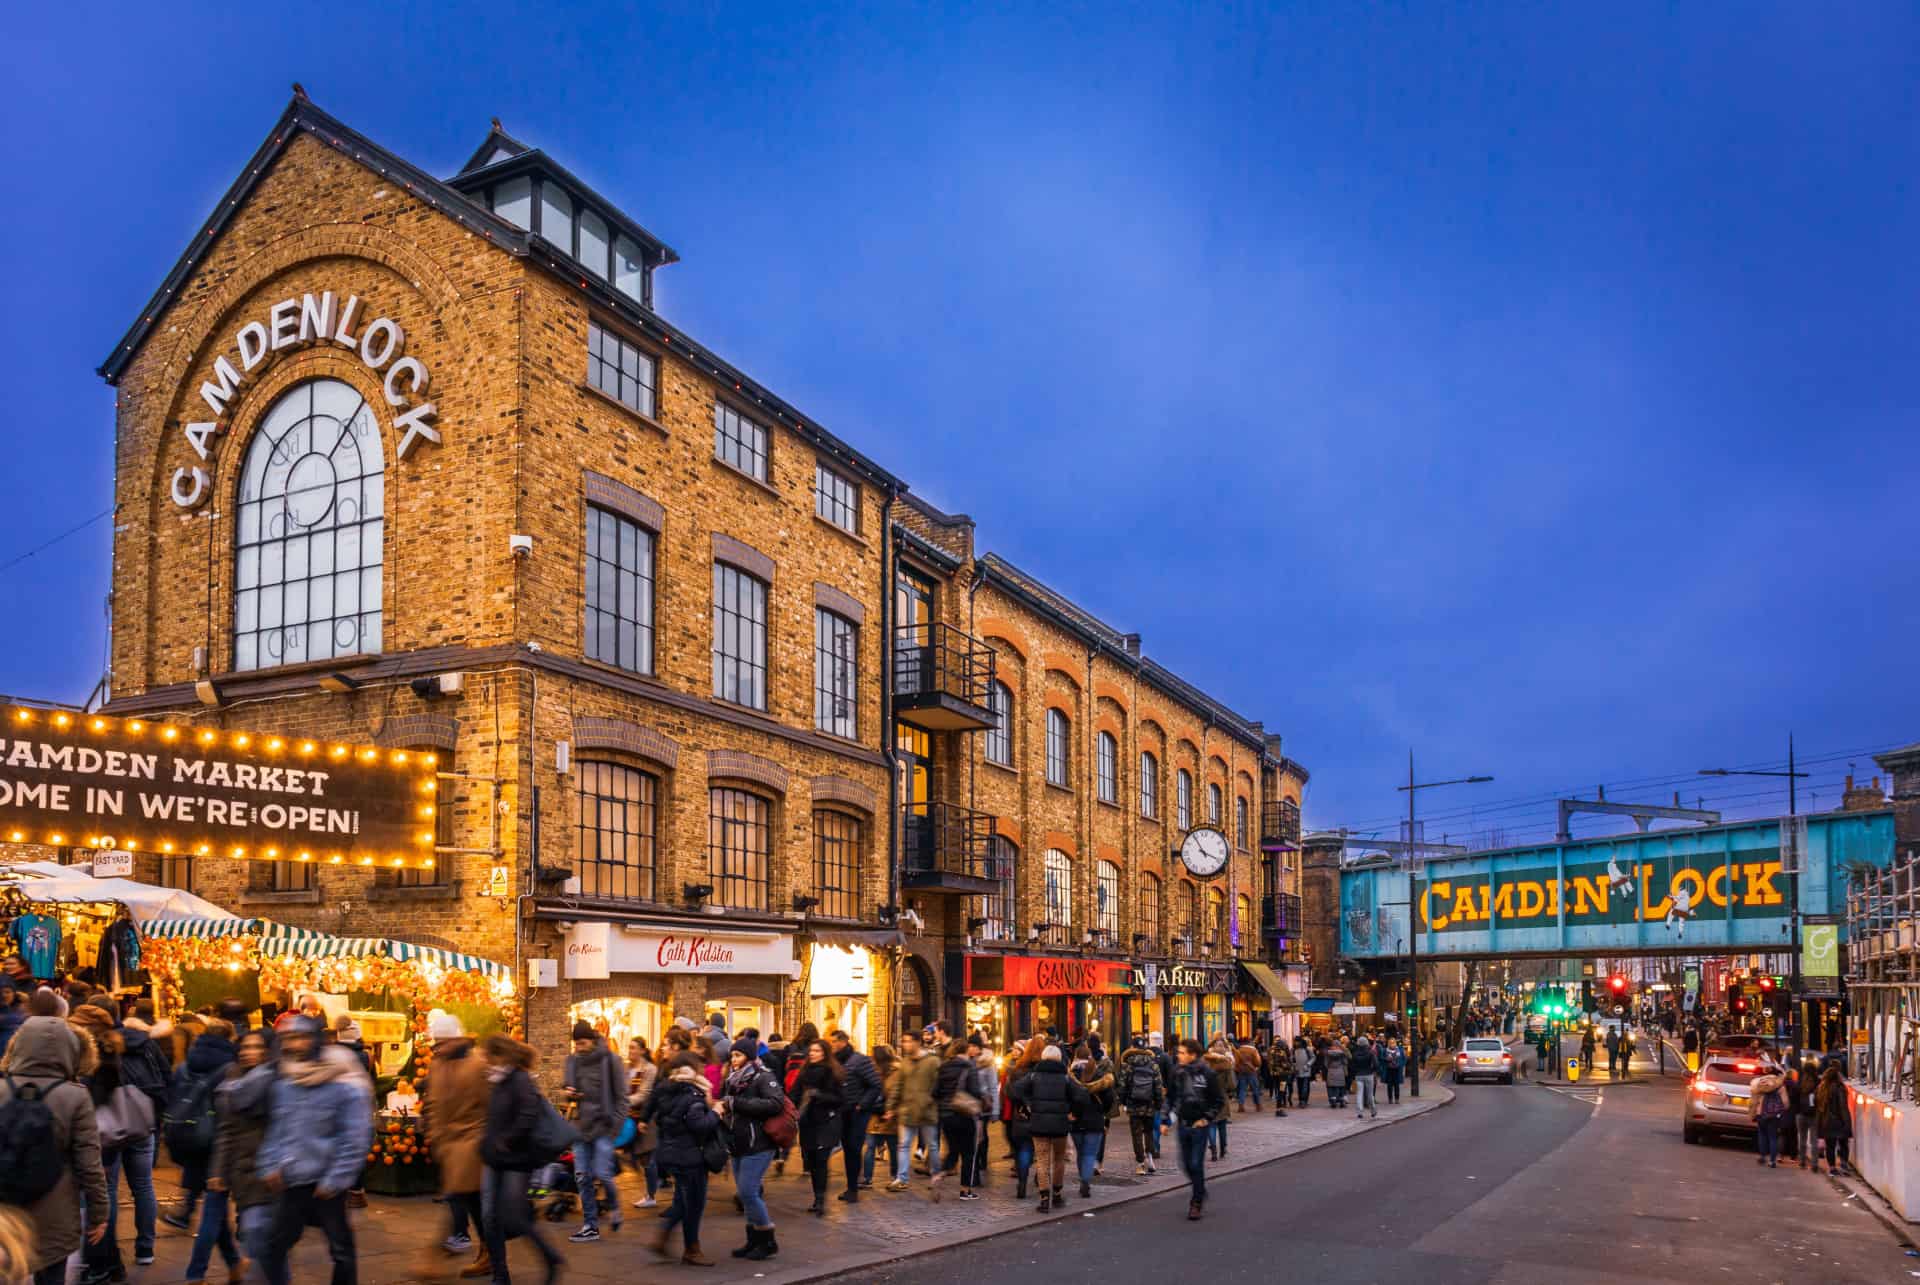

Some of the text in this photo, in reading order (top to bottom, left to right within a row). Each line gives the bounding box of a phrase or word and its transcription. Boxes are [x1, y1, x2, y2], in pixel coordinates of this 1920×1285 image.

[171, 291, 441, 507] CAMDEN LOCK
[0, 738, 330, 797] AMDEN MARKET
[86, 787, 124, 816] IN
[139, 792, 249, 827] WE'RE
[1419, 861, 1784, 931] CAMDEN LOCK
[657, 935, 735, 967] Cath Kidston
